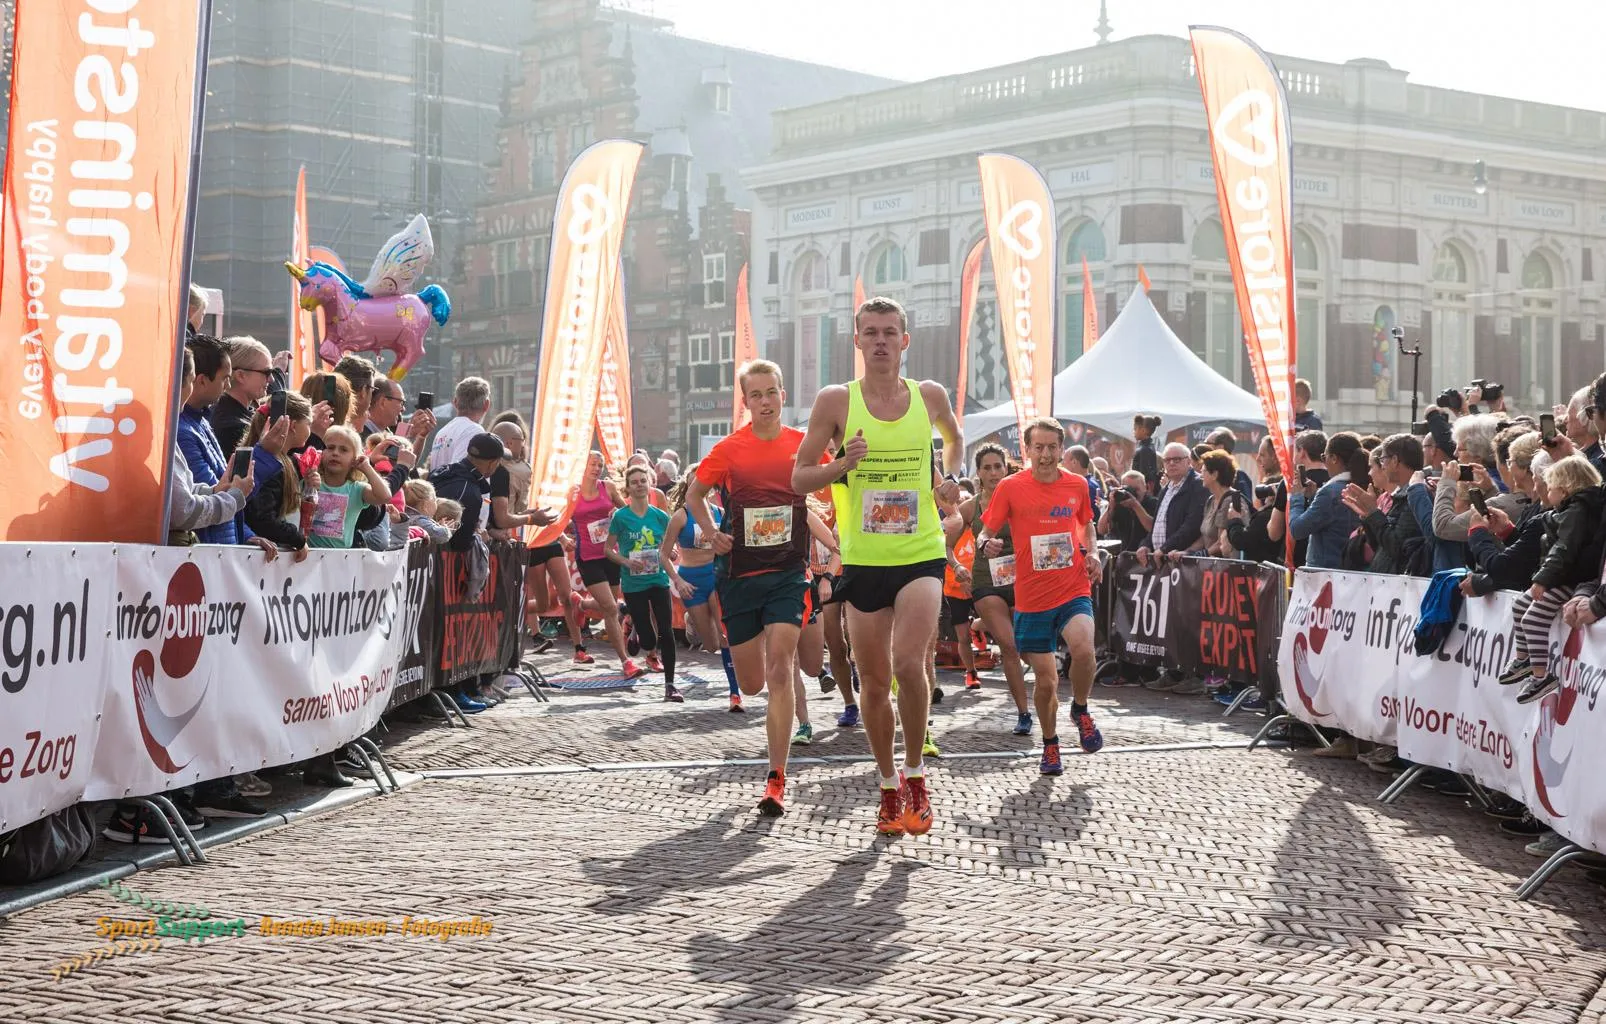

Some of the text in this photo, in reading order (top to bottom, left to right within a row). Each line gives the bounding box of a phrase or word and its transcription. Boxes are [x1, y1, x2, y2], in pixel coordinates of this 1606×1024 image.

[791, 207, 832, 224] MODERNE
[283, 692, 335, 725] samen
[333, 680, 360, 715] Voor
[20, 730, 77, 780] Zorg
[1405, 695, 1455, 735] Voor
[1479, 719, 1513, 769] Zorg
